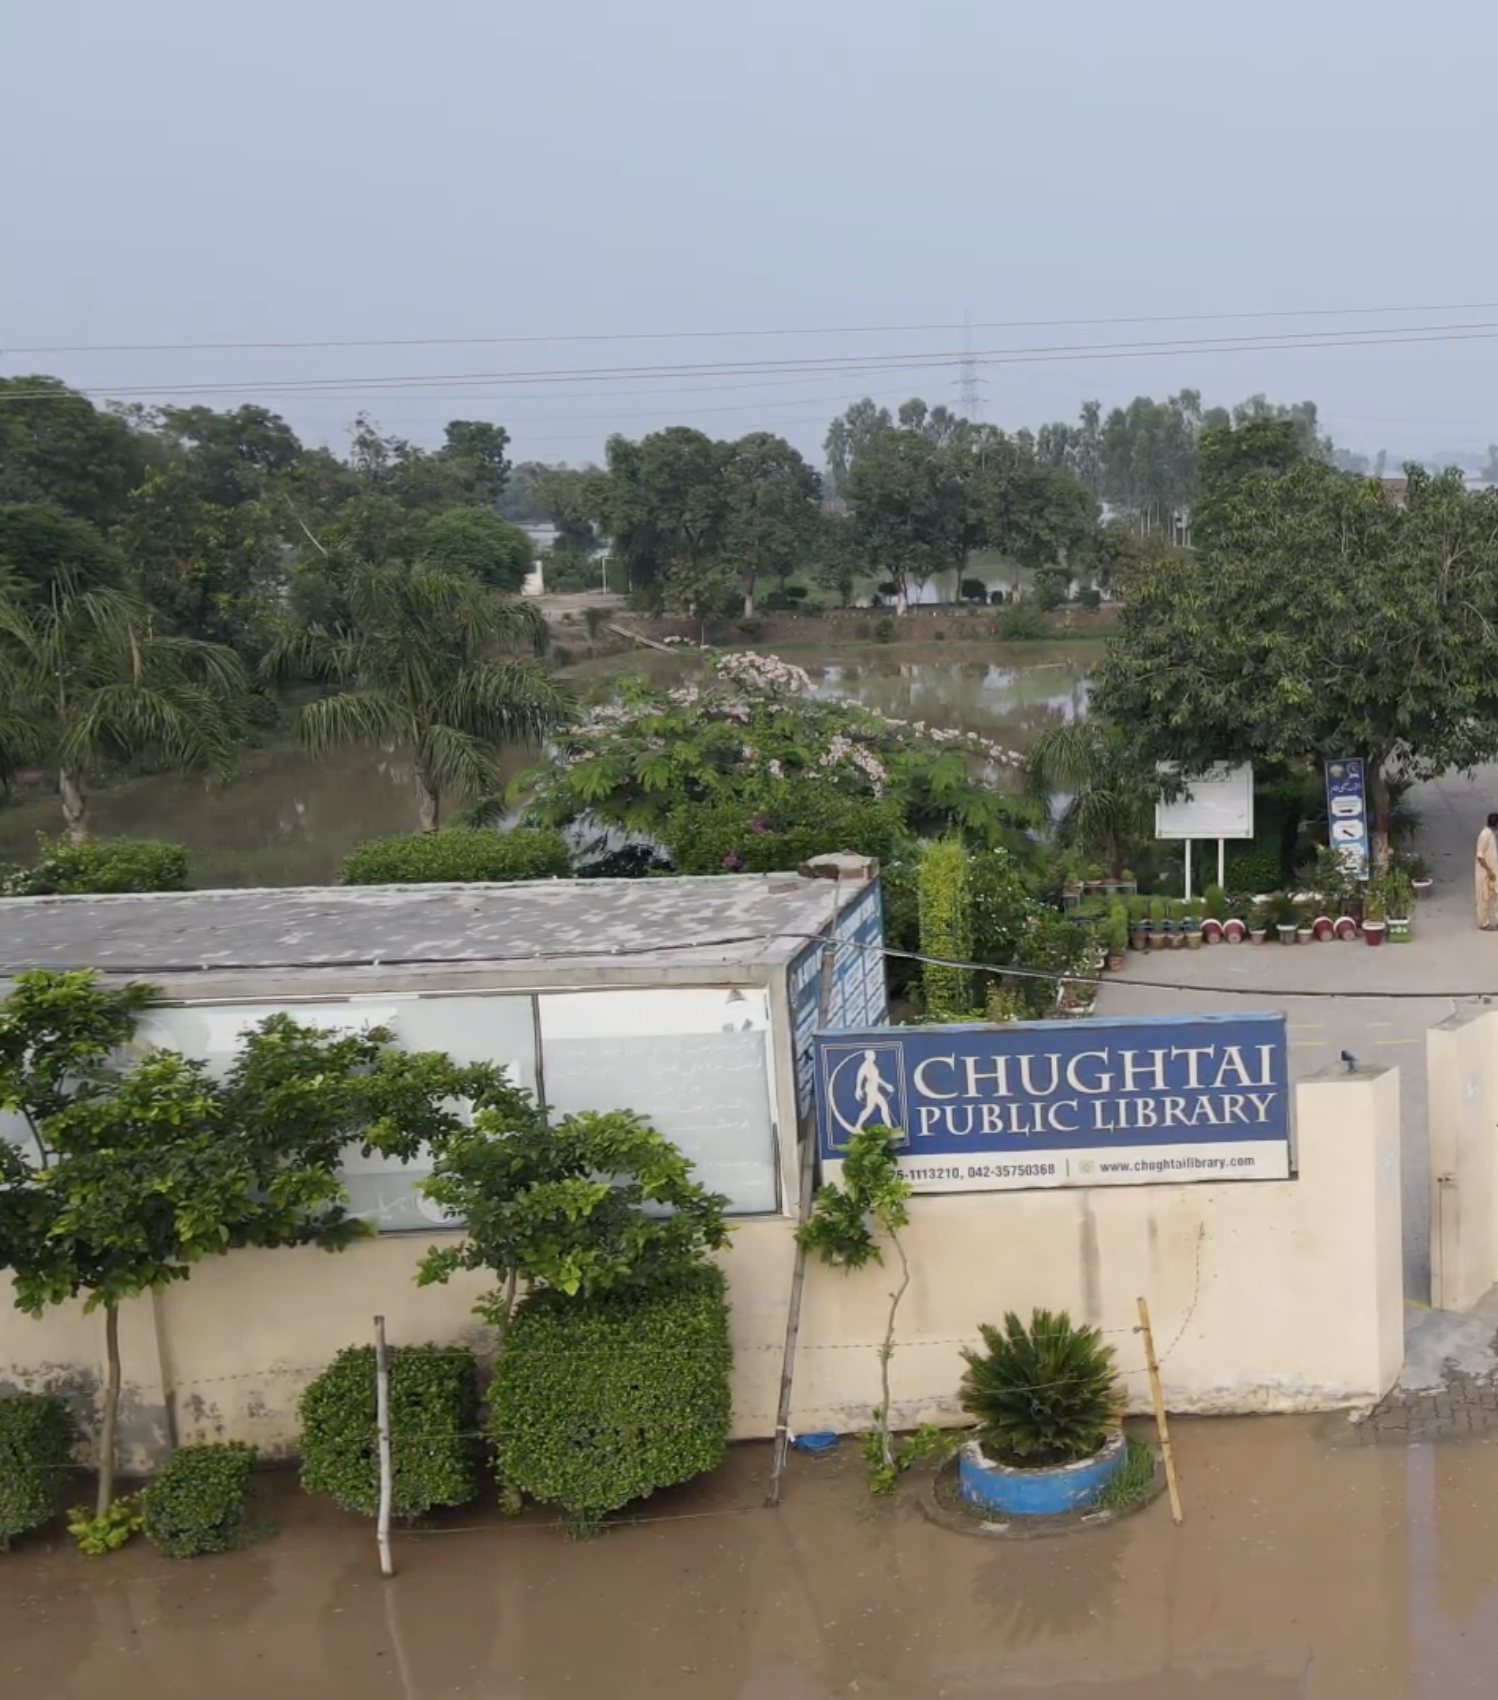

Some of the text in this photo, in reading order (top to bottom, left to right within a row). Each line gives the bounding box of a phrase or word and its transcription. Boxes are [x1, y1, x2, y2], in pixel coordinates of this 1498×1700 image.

[913, 1044, 1277, 1100] CHUGHTAI
[917, 1092, 1278, 1137] PUBLIC LIBRARY
[888, 1166, 964, 1181] 25-1113210,
